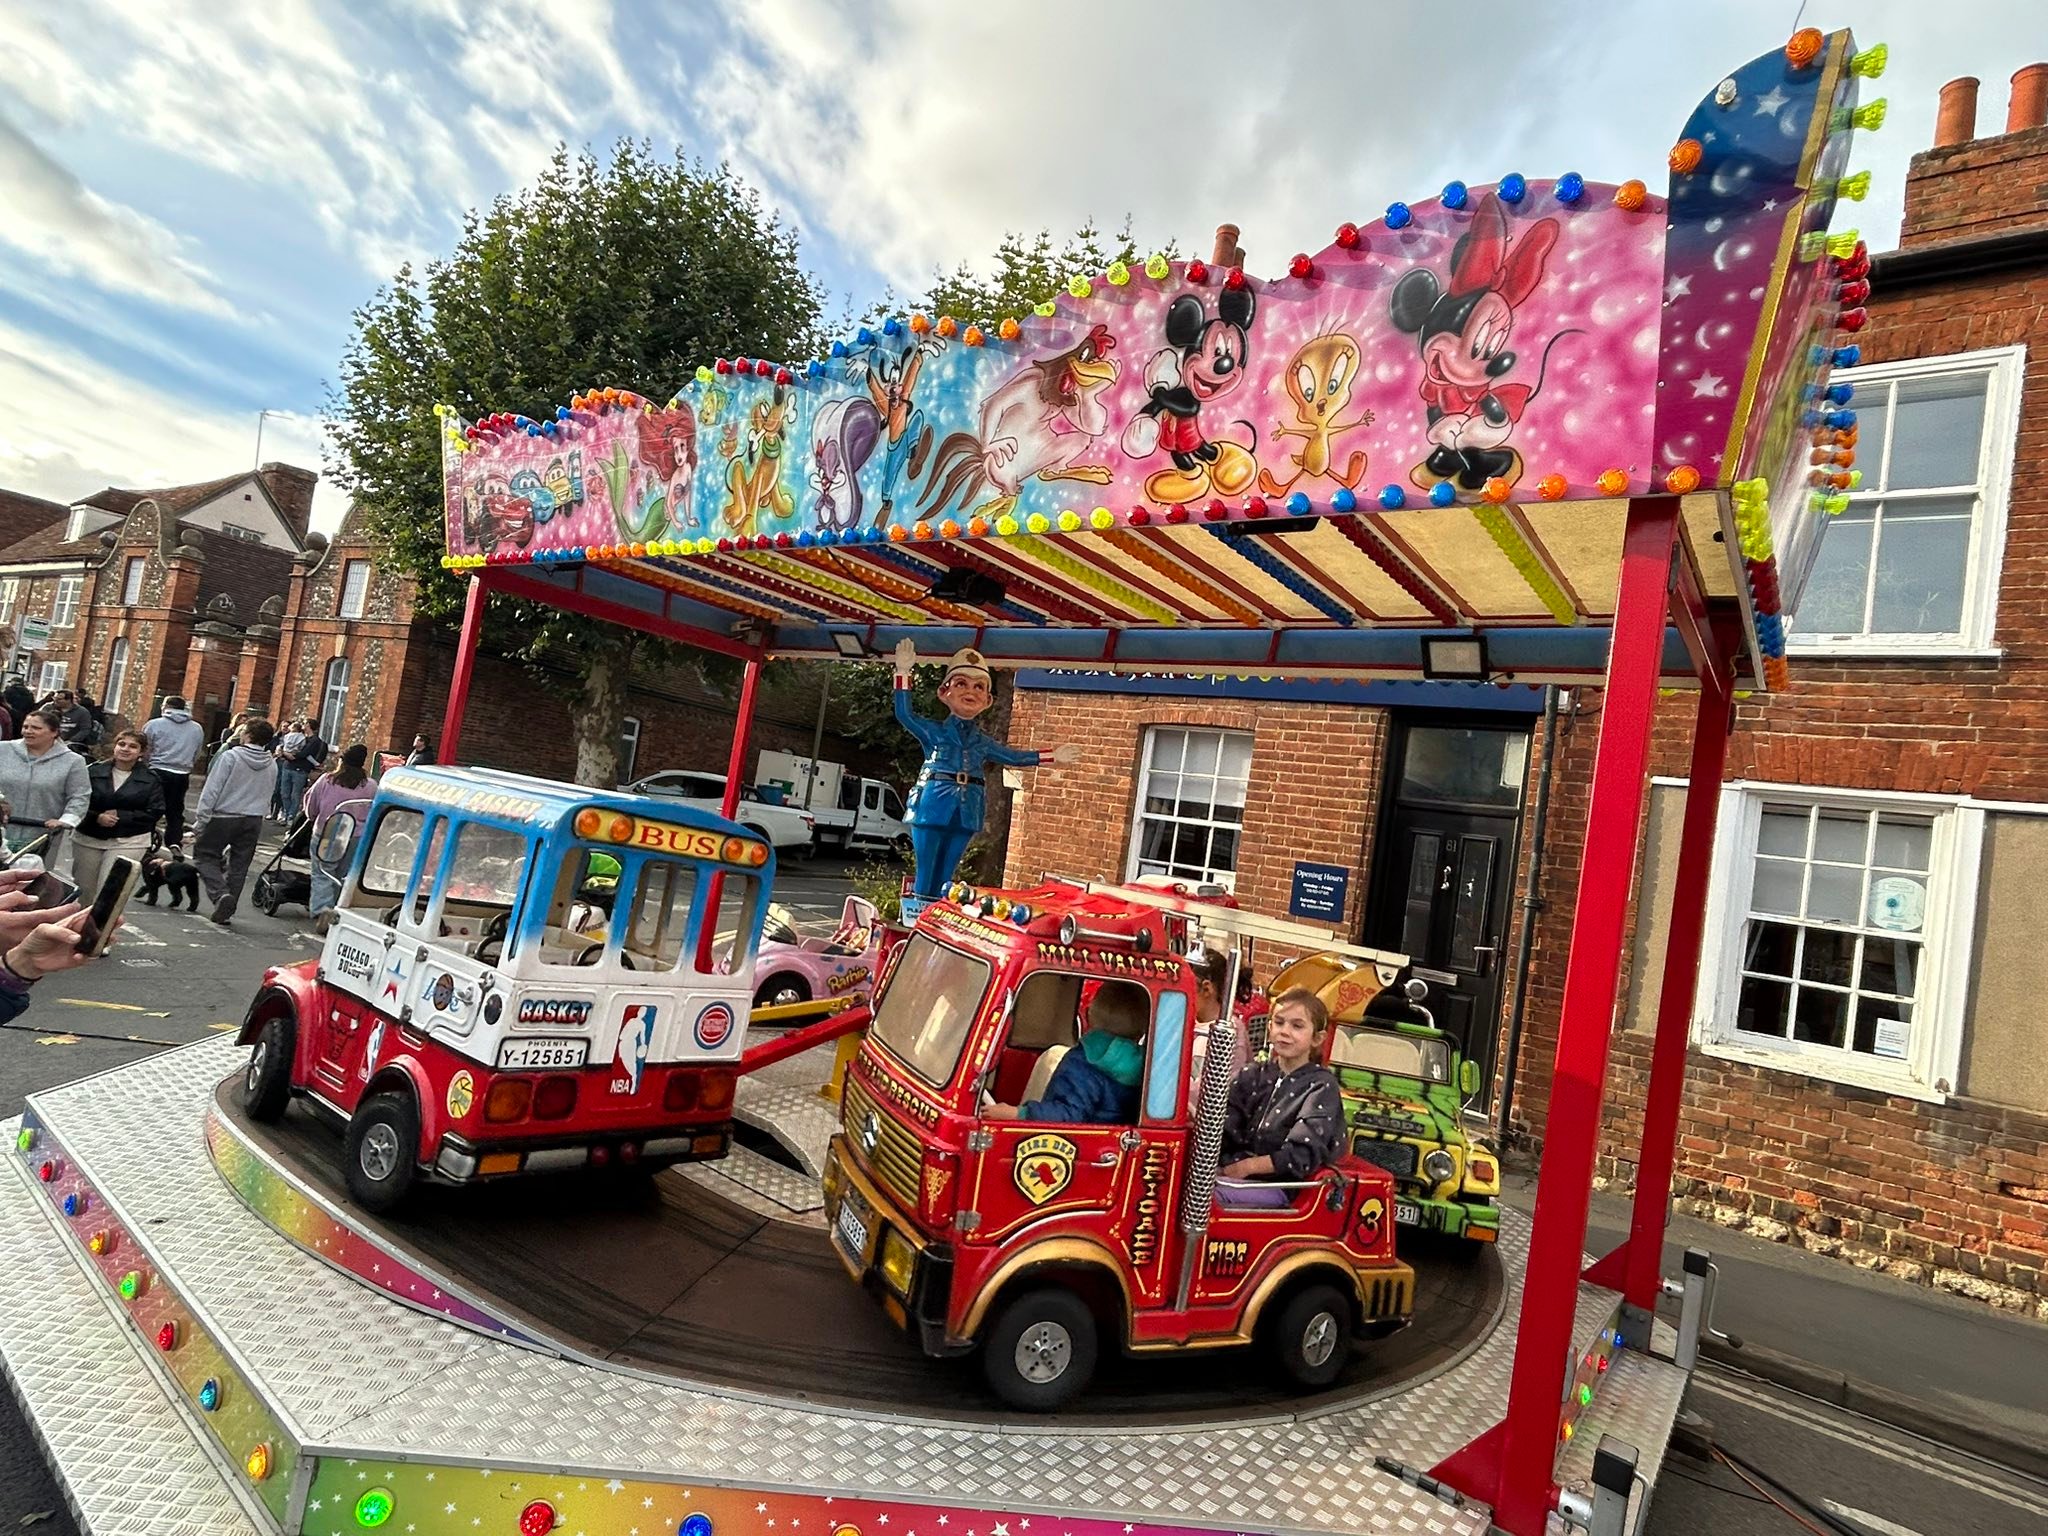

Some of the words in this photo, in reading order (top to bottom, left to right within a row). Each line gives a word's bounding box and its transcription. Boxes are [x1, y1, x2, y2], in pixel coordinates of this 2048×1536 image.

[390, 776, 466, 805] AMERICAN
[468, 792, 543, 818] BASKET
[639, 825, 716, 856] BUS
[1446, 840, 1457, 852] 81
[1296, 869, 1323, 881] Opening
[1324, 873, 1343, 882] Hours
[337, 943, 370, 966] CHICAGO
[1038, 942, 1094, 969] MILL
[1099, 950, 1181, 982] VALLEY
[519, 999, 593, 1025] BASKET
[528, 1040, 568, 1048] PHOENIX
[502, 1049, 584, 1066] Y-125851
[609, 1079, 630, 1094] NBA
[887, 1080, 940, 1128] RESCUE
[1019, 1138, 1049, 1155] FIRE
[1053, 1140, 1074, 1155] DEP
[1357, 1198, 1384, 1245] 3
[1206, 1241, 1248, 1275] FIRE
